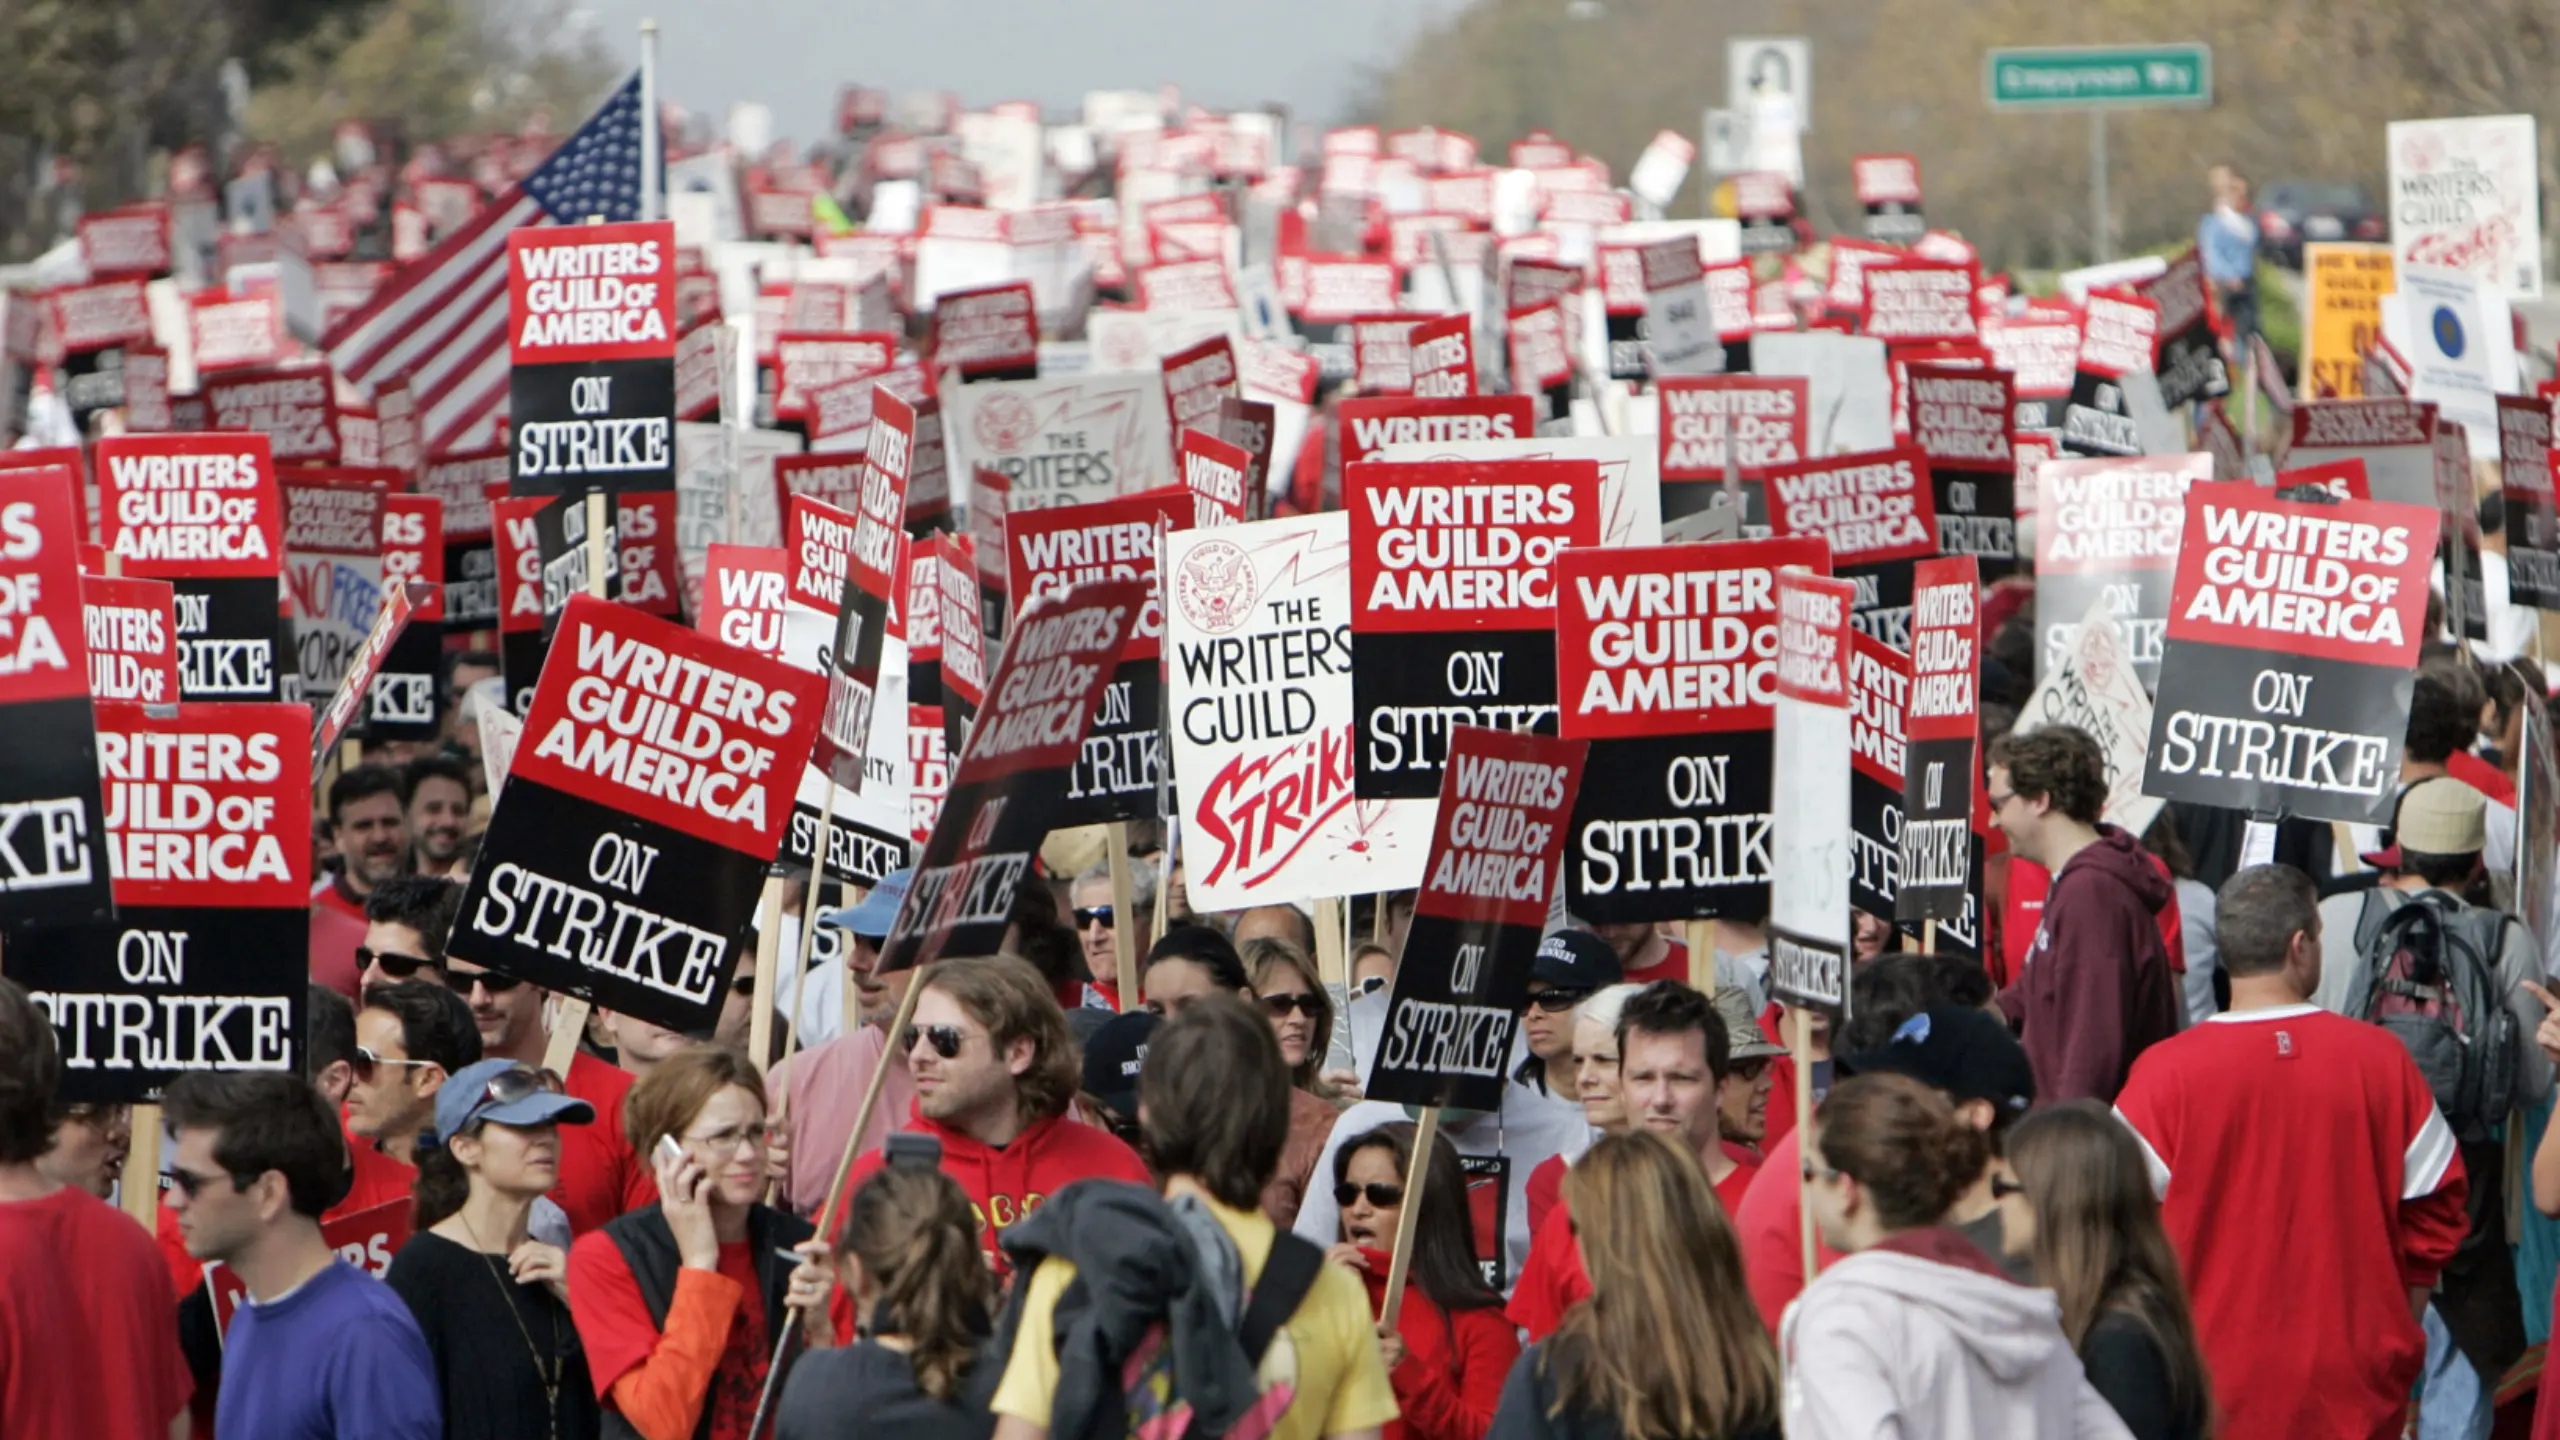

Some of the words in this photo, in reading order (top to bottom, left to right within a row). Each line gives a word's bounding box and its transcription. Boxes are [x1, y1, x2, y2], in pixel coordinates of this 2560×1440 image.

[519, 241, 660, 280] WRITERS
[526, 277, 622, 313] GUILD
[624, 283, 657, 307] OF
[519, 309, 667, 348] AMERICA
[570, 376, 612, 414] ON
[1665, 388, 1797, 416] WRITERS
[1911, 377, 2006, 404] WRITERS
[518, 416, 669, 477] STRIKE
[1045, 432, 1089, 448] THE
[1352, 413, 1516, 451] WRITERS
[1918, 431, 2011, 460] AMERICA
[109, 454, 258, 490] WRITERS
[783, 463, 864, 493] WRIT
[1185, 450, 1243, 508] WRITERS
[1775, 460, 1915, 502] WRITERS
[117, 489, 221, 526] GUILD
[221, 498, 257, 524] OF
[287, 487, 378, 510] WRITERS
[1365, 483, 1575, 527] WRITERS
[1786, 494, 1881, 531] GUILD
[1881, 494, 1914, 516] OF
[1948, 482, 1977, 513] ON
[2057, 501, 2157, 532] GUILD
[114, 525, 268, 561] AMERICA
[801, 509, 854, 553] WRIT
[1018, 519, 1170, 571] WRITER
[1376, 527, 1522, 569] GUILD
[1937, 515, 2014, 559] TRIKE
[2048, 528, 2182, 563] AMERIC
[2203, 503, 2410, 567] WRITERS
[386, 551, 422, 573] OF
[621, 546, 655, 571] OF
[2204, 546, 2349, 597] GUILD
[2350, 573, 2400, 604] OF
[1267, 596, 1322, 626] THE
[1366, 568, 1558, 611] AMERIC
[1575, 568, 1778, 621] WRITER
[1779, 585, 1841, 629] WRITERS
[1917, 582, 1974, 628] WRITERS
[84, 603, 166, 655] RITERS
[1013, 604, 1126, 665] WRITERS
[2184, 583, 2405, 647] AMERICA
[298, 629, 361, 683] ORK
[1178, 623, 1354, 690] WRITERS
[1589, 617, 1748, 668] GUILD
[1751, 630, 1778, 659] O
[1915, 629, 1957, 673] GUILD
[1957, 638, 1972, 671] OF
[87, 652, 141, 700] UILD
[140, 666, 165, 702] OF
[576, 622, 796, 737] WRITERS
[997, 653, 1068, 713] GUILD
[1065, 663, 1100, 697] OF
[1446, 650, 1504, 697] ON
[1578, 660, 1779, 715] AMERIC
[1910, 672, 1974, 718] AMERICA
[2251, 668, 2313, 717] ON
[566, 675, 722, 759] GUILD
[720, 739, 775, 779] OF
[968, 700, 1087, 761] AMERICA
[1182, 686, 1317, 747] GUILD
[97, 731, 282, 783] RITERS
[534, 717, 767, 832] AMERICA
[2159, 710, 2389, 797] STRIKE
[1456, 753, 1568, 811] WRITERS
[1667, 755, 1730, 808] ON
[1924, 761, 1945, 811] ON
[215, 796, 276, 832] OF
[1450, 801, 1524, 851] GUILD
[1522, 823, 1552, 854] OF
[108, 833, 292, 882] ERICA
[588, 831, 659, 895] ON
[1429, 849, 1545, 902] AMERICA
[1581, 813, 1776, 895] STRIK
[1900, 818, 1968, 889] STRIKE
[898, 851, 1031, 943] STRIKE
[117, 928, 190, 985] ON
[472, 861, 727, 1005] STRIKE
[1451, 943, 1485, 994] ON
[1775, 936, 1841, 1005] STRIKE
[1381, 997, 1512, 1078] STRIKE
